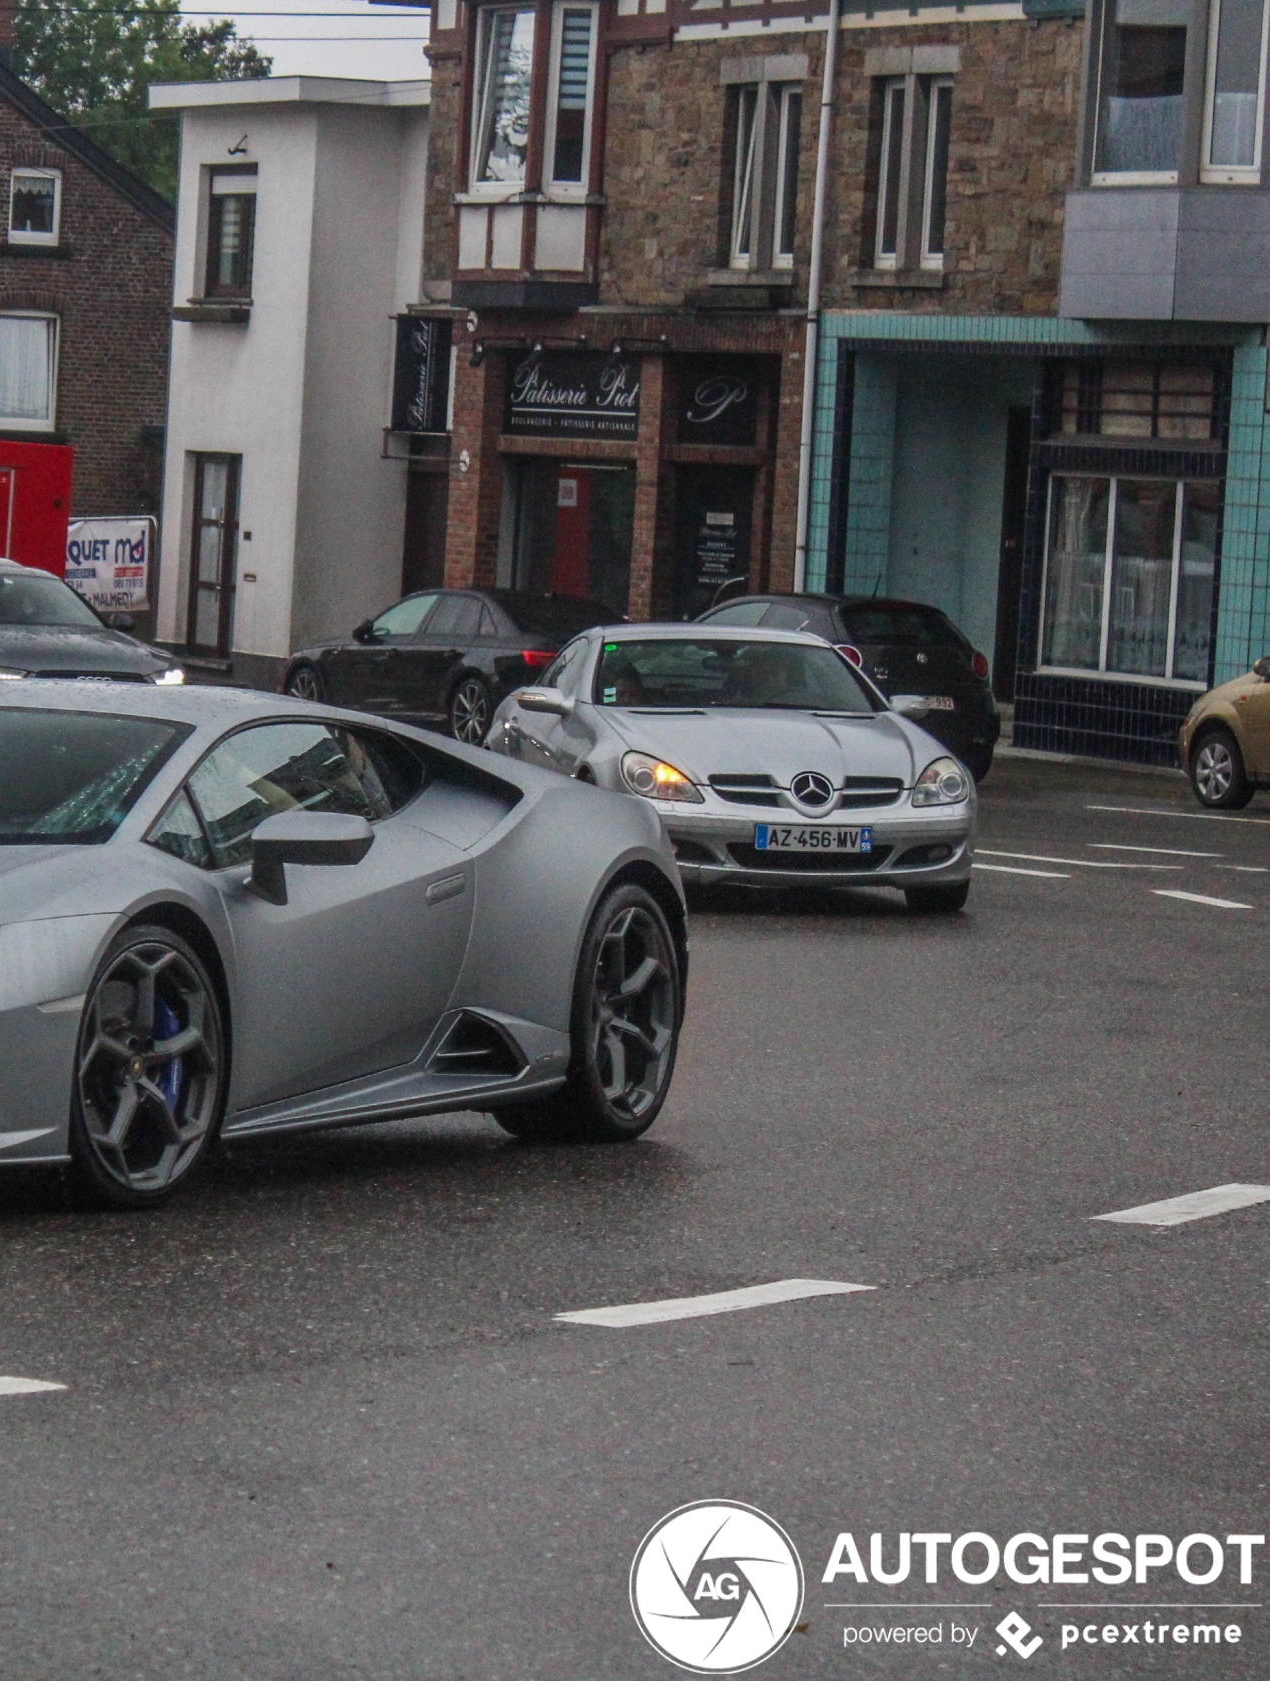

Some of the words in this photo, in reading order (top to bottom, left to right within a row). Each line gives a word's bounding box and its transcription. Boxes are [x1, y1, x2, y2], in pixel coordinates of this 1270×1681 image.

[596, 364, 640, 408] Piot
[66, 539, 109, 566] QUET
[92, 591, 135, 607] MALMEDY
[768, 829, 859, 849] AZ-456-MV
[860, 842, 871, 851] 59
